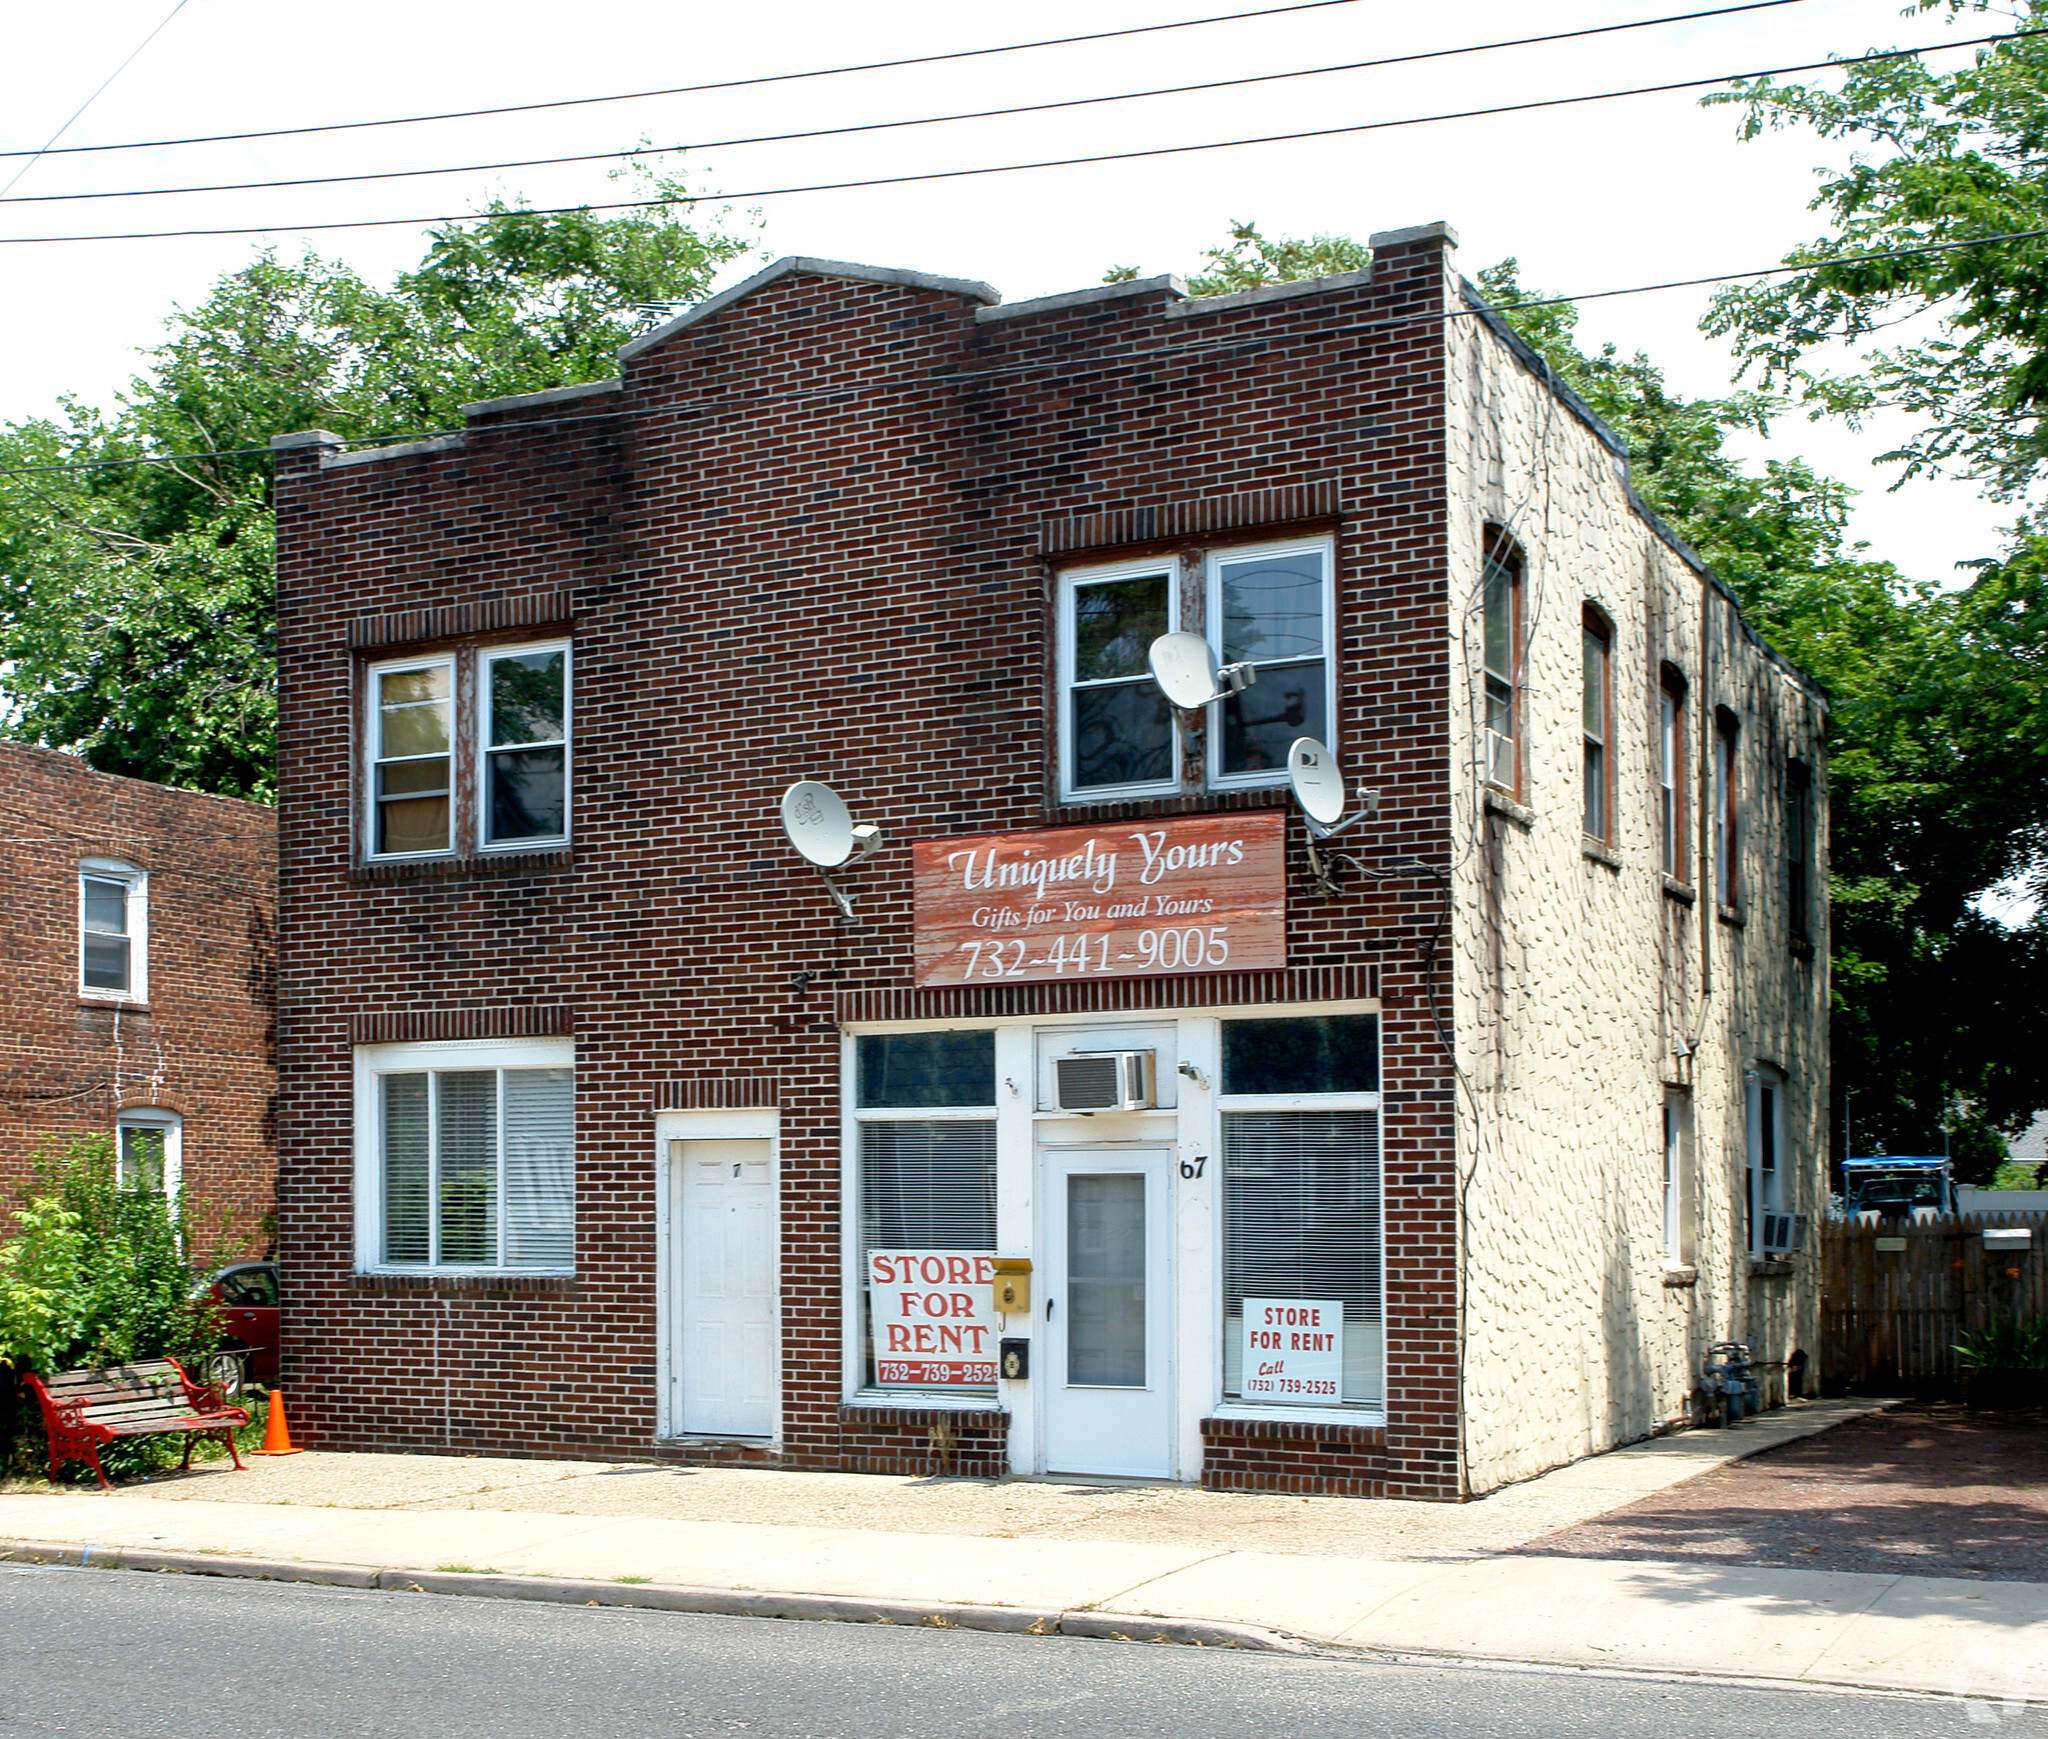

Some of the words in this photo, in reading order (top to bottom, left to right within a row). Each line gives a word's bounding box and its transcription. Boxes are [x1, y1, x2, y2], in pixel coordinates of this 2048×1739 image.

[948, 838, 1117, 899] Uniquely
[1130, 831, 1244, 886] Yours
[971, 905, 1020, 933] Gifts
[1023, 903, 1057, 932] for
[1063, 901, 1100, 923] You
[1107, 895, 1148, 918] and
[1156, 894, 1213, 916] Yours
[960, 926, 1230, 981] 732-441-9005
[732, 1163, 742, 1178] 7
[1180, 1155, 1209, 1180] 67
[872, 1255, 994, 1285] STORE
[899, 1292, 976, 1318] FOR
[1264, 1307, 1320, 1327] STORE
[886, 1323, 989, 1354] RENT
[1250, 1331, 1282, 1350] FOR
[1291, 1332, 1334, 1352] RENT
[1258, 1360, 1285, 1376] Call
[1247, 1379, 1275, 1392] (732)
[1279, 1379, 1337, 1395] 739-2525
